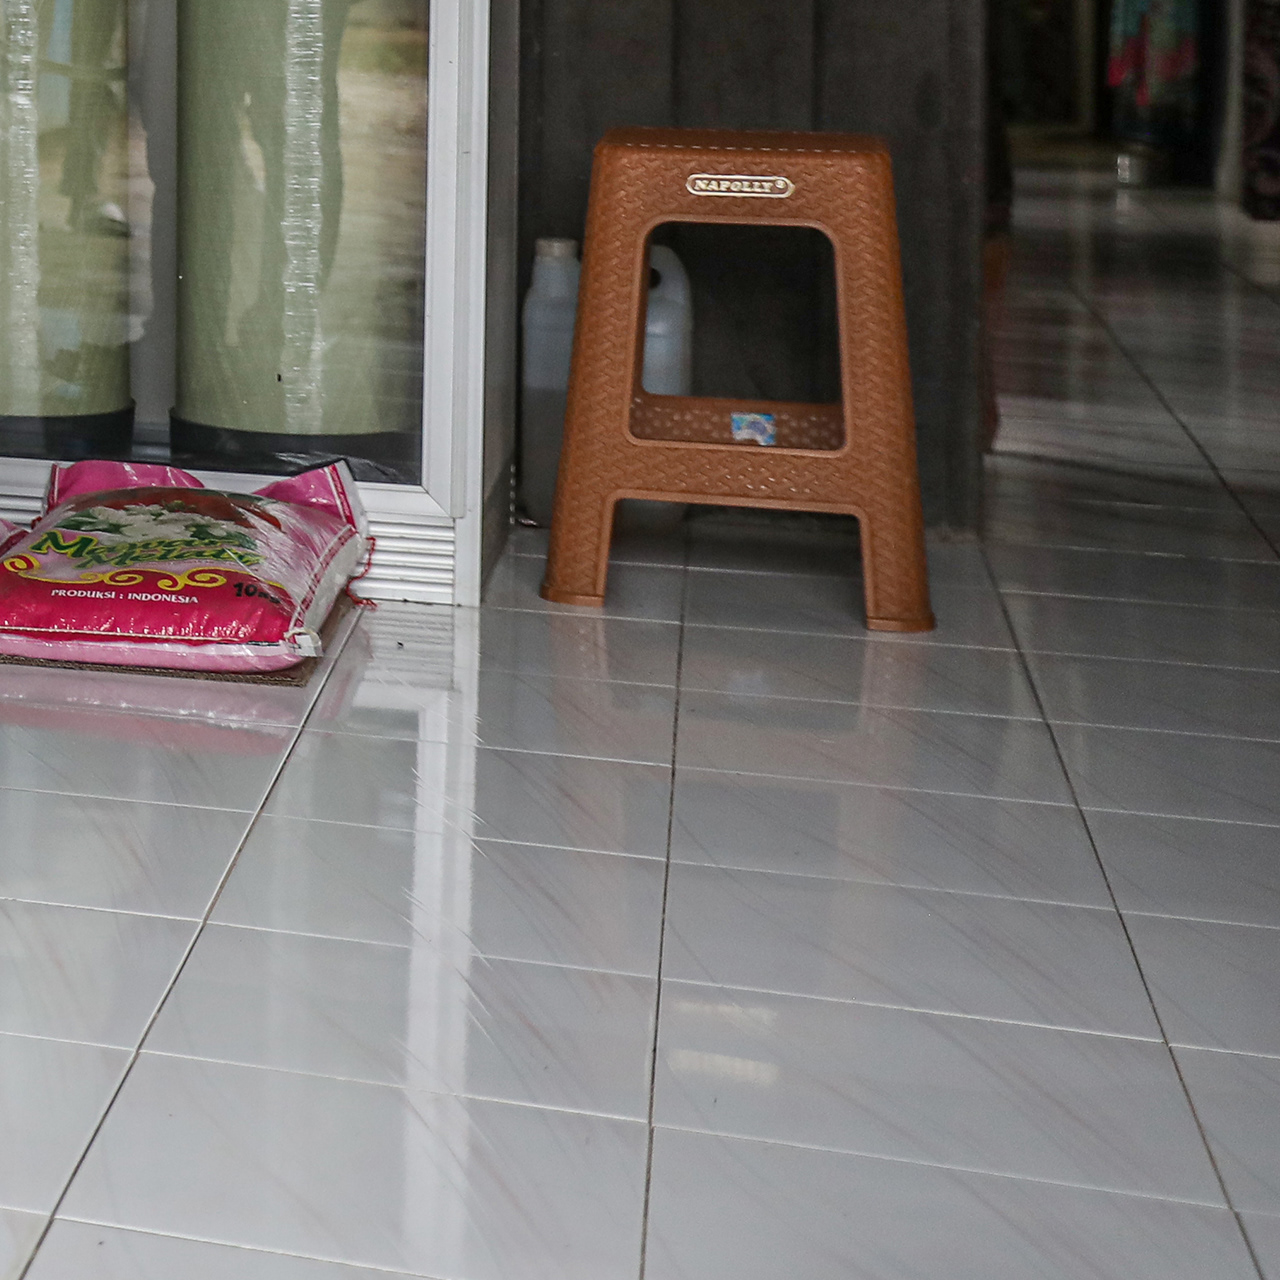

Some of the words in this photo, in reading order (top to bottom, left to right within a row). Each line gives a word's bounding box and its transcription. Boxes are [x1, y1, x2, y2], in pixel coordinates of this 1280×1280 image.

[694, 180, 773, 192] NAPOLLY
[51, 588, 115, 600] PRODUKSI
[128, 592, 198, 604] INDONESIA
